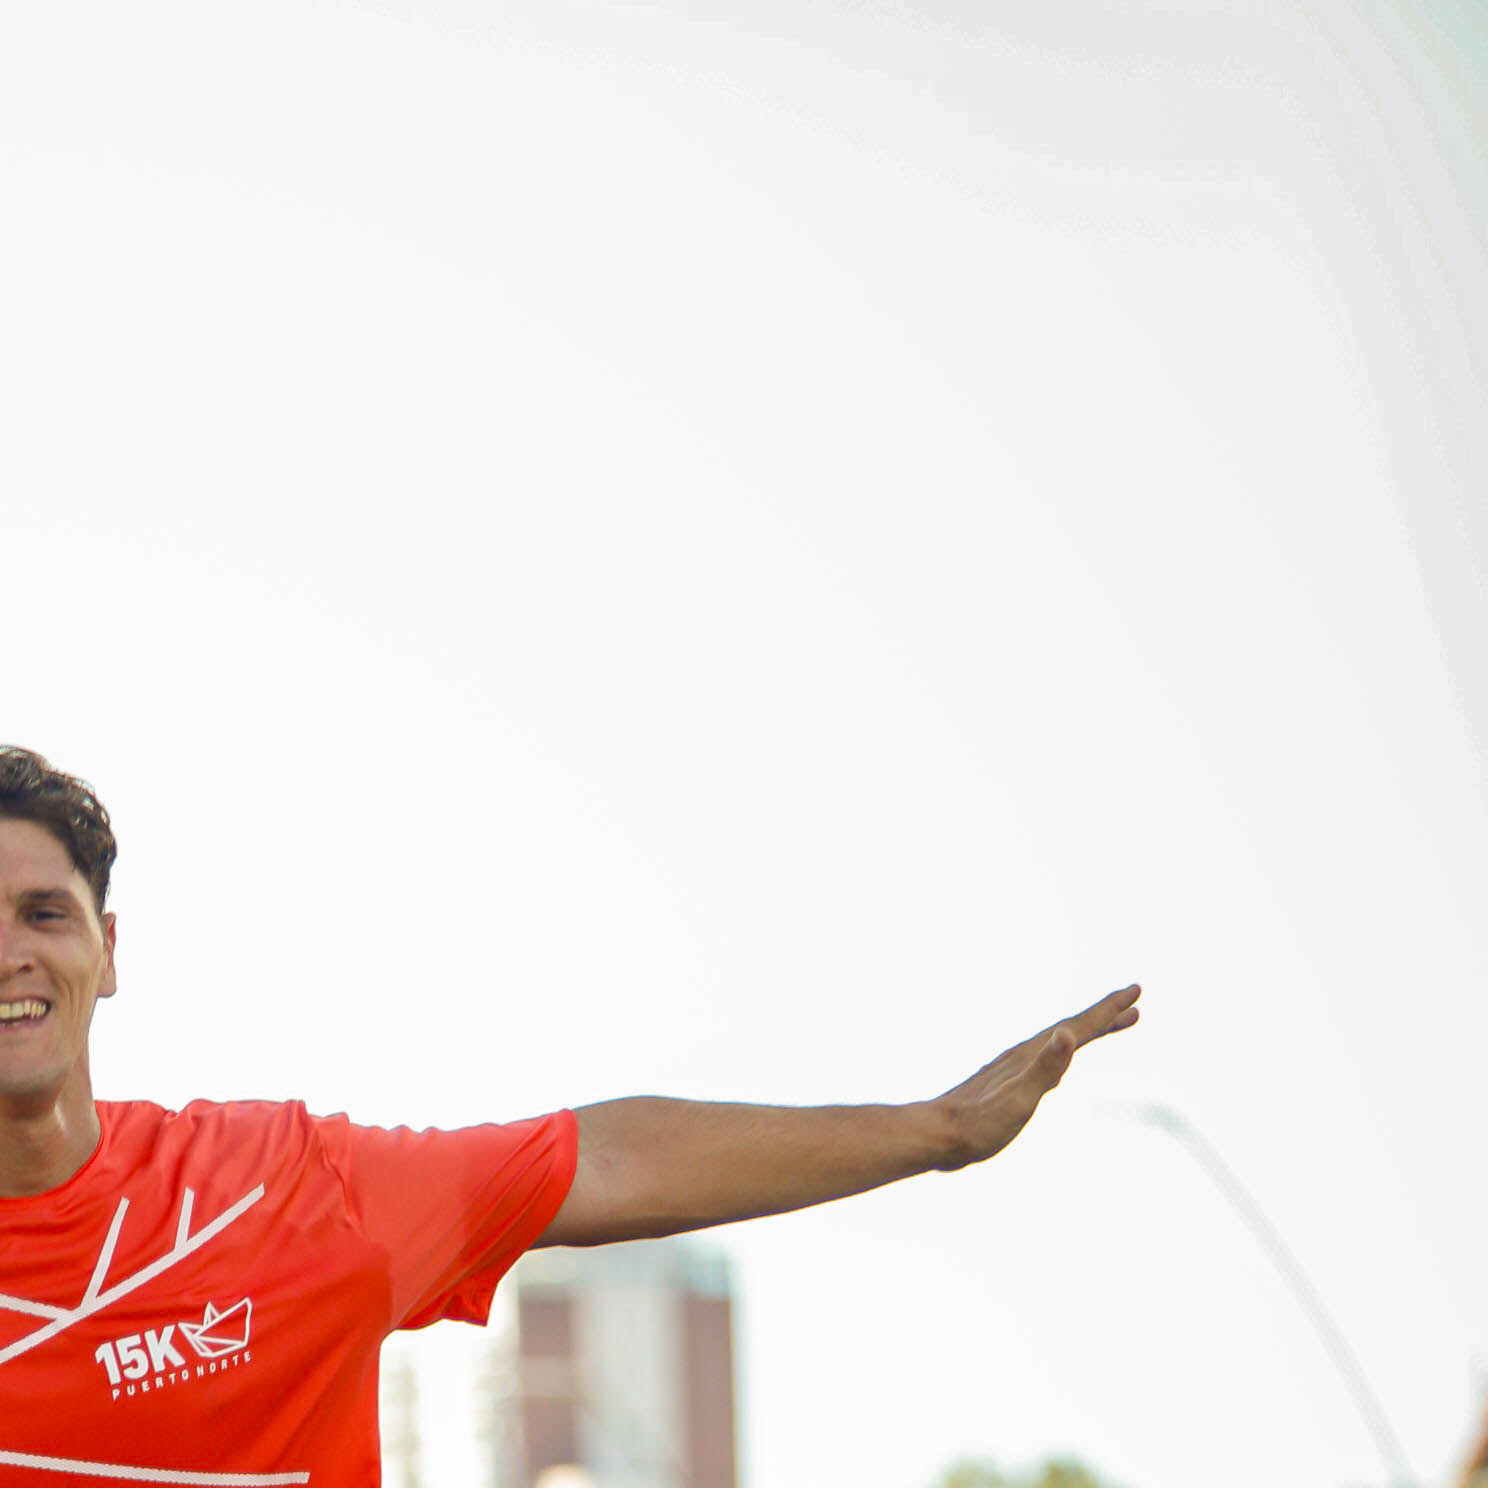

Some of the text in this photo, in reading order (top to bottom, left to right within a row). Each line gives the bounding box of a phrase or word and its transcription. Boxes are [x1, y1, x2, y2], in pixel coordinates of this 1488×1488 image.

[95, 1324, 186, 1385] 15K
[112, 1351, 251, 1401] PUERTO NORTE
